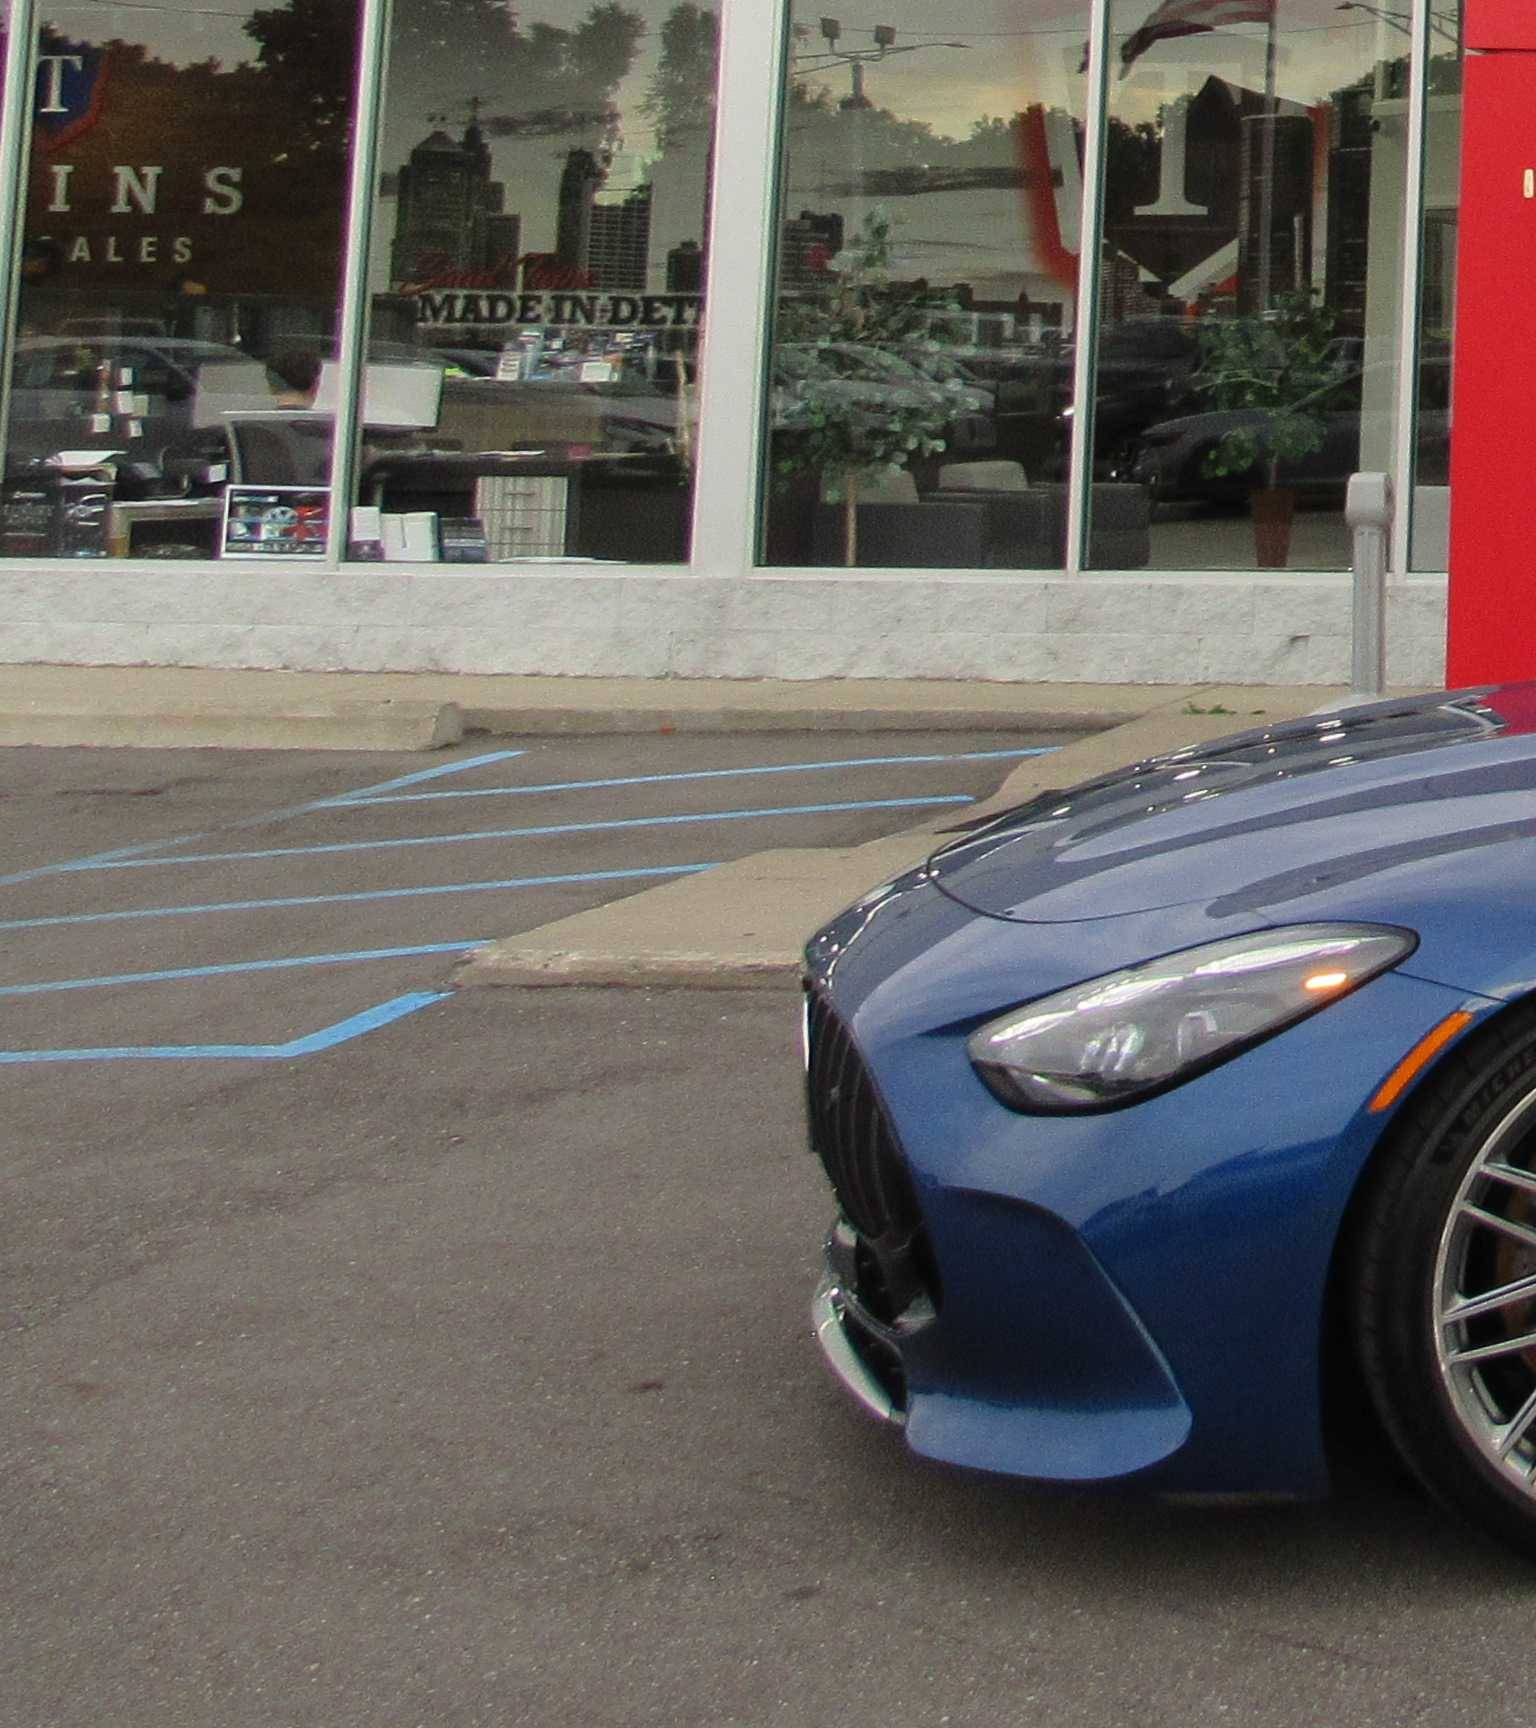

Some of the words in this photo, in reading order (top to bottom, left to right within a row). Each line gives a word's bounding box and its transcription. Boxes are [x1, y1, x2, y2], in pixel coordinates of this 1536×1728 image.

[37, 55, 83, 112] T
[47, 164, 244, 215] INS
[40, 235, 194, 263] ALES
[418, 293, 544, 324] MADE
[551, 294, 600, 324] IN
